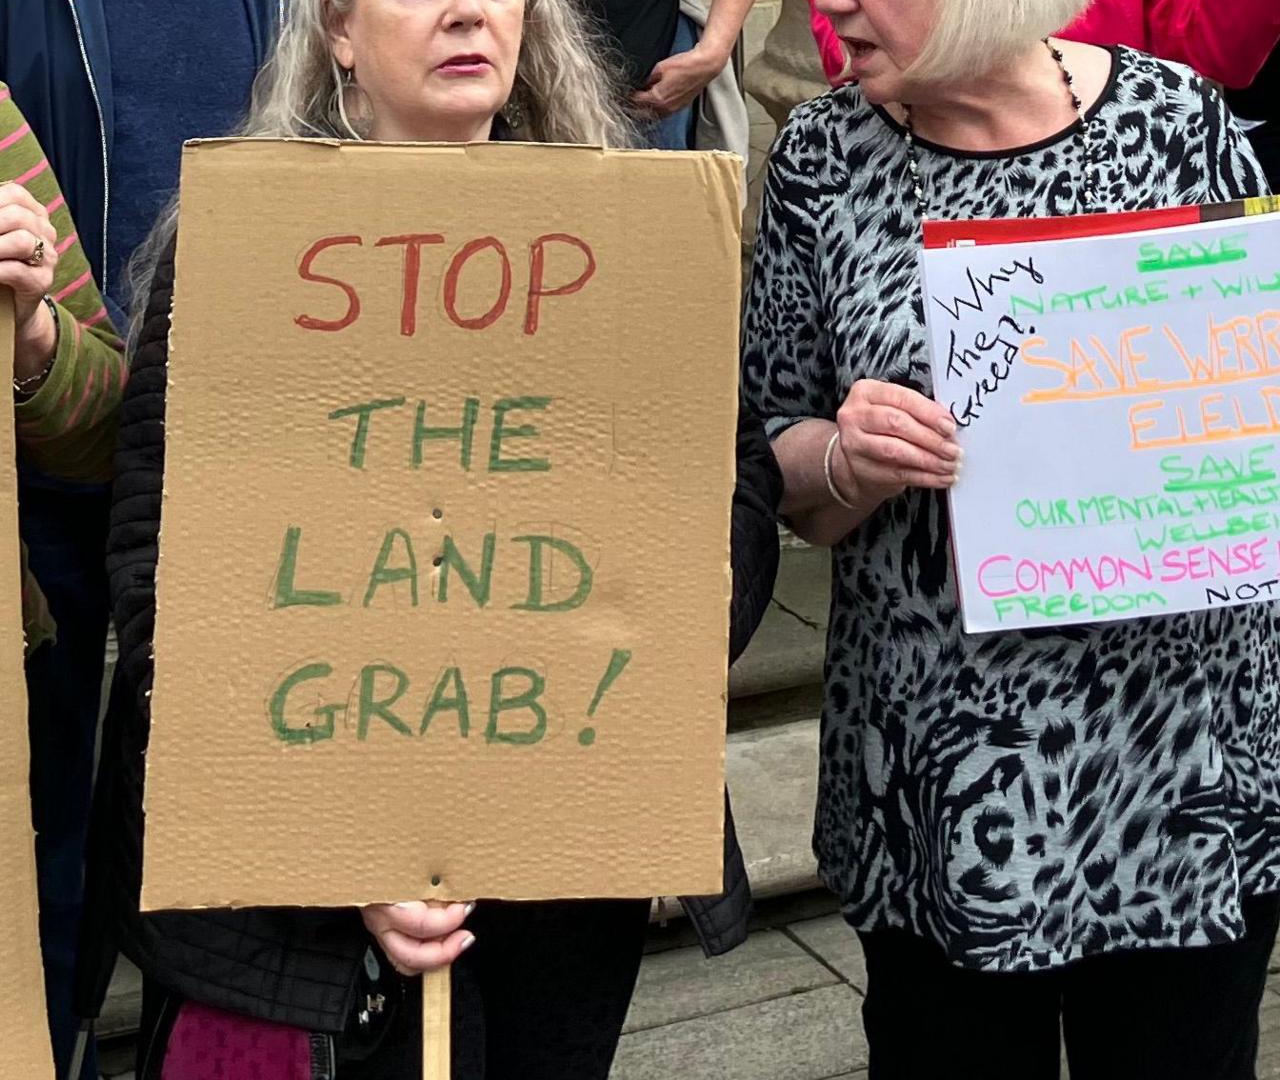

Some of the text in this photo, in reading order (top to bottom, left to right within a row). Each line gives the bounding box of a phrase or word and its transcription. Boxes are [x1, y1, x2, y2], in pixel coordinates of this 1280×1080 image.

[1136, 231, 1248, 266] SAVE
[293, 232, 597, 336] STOP
[932, 256, 1045, 321] Why
[1008, 279, 1169, 317] NATURE
[946, 329, 1000, 381] The
[1021, 324, 1153, 392] SAVE
[327, 395, 553, 473] THE
[1159, 444, 1276, 482] SAVE
[1014, 498, 1076, 528] OUR
[1077, 492, 1193, 525] MENTAL
[270, 526, 595, 612] LAND
[977, 554, 1154, 598] COMMON
[1161, 537, 1268, 582] SENSE
[1205, 579, 1279, 605] NOT
[269, 648, 632, 746] GRAB!
